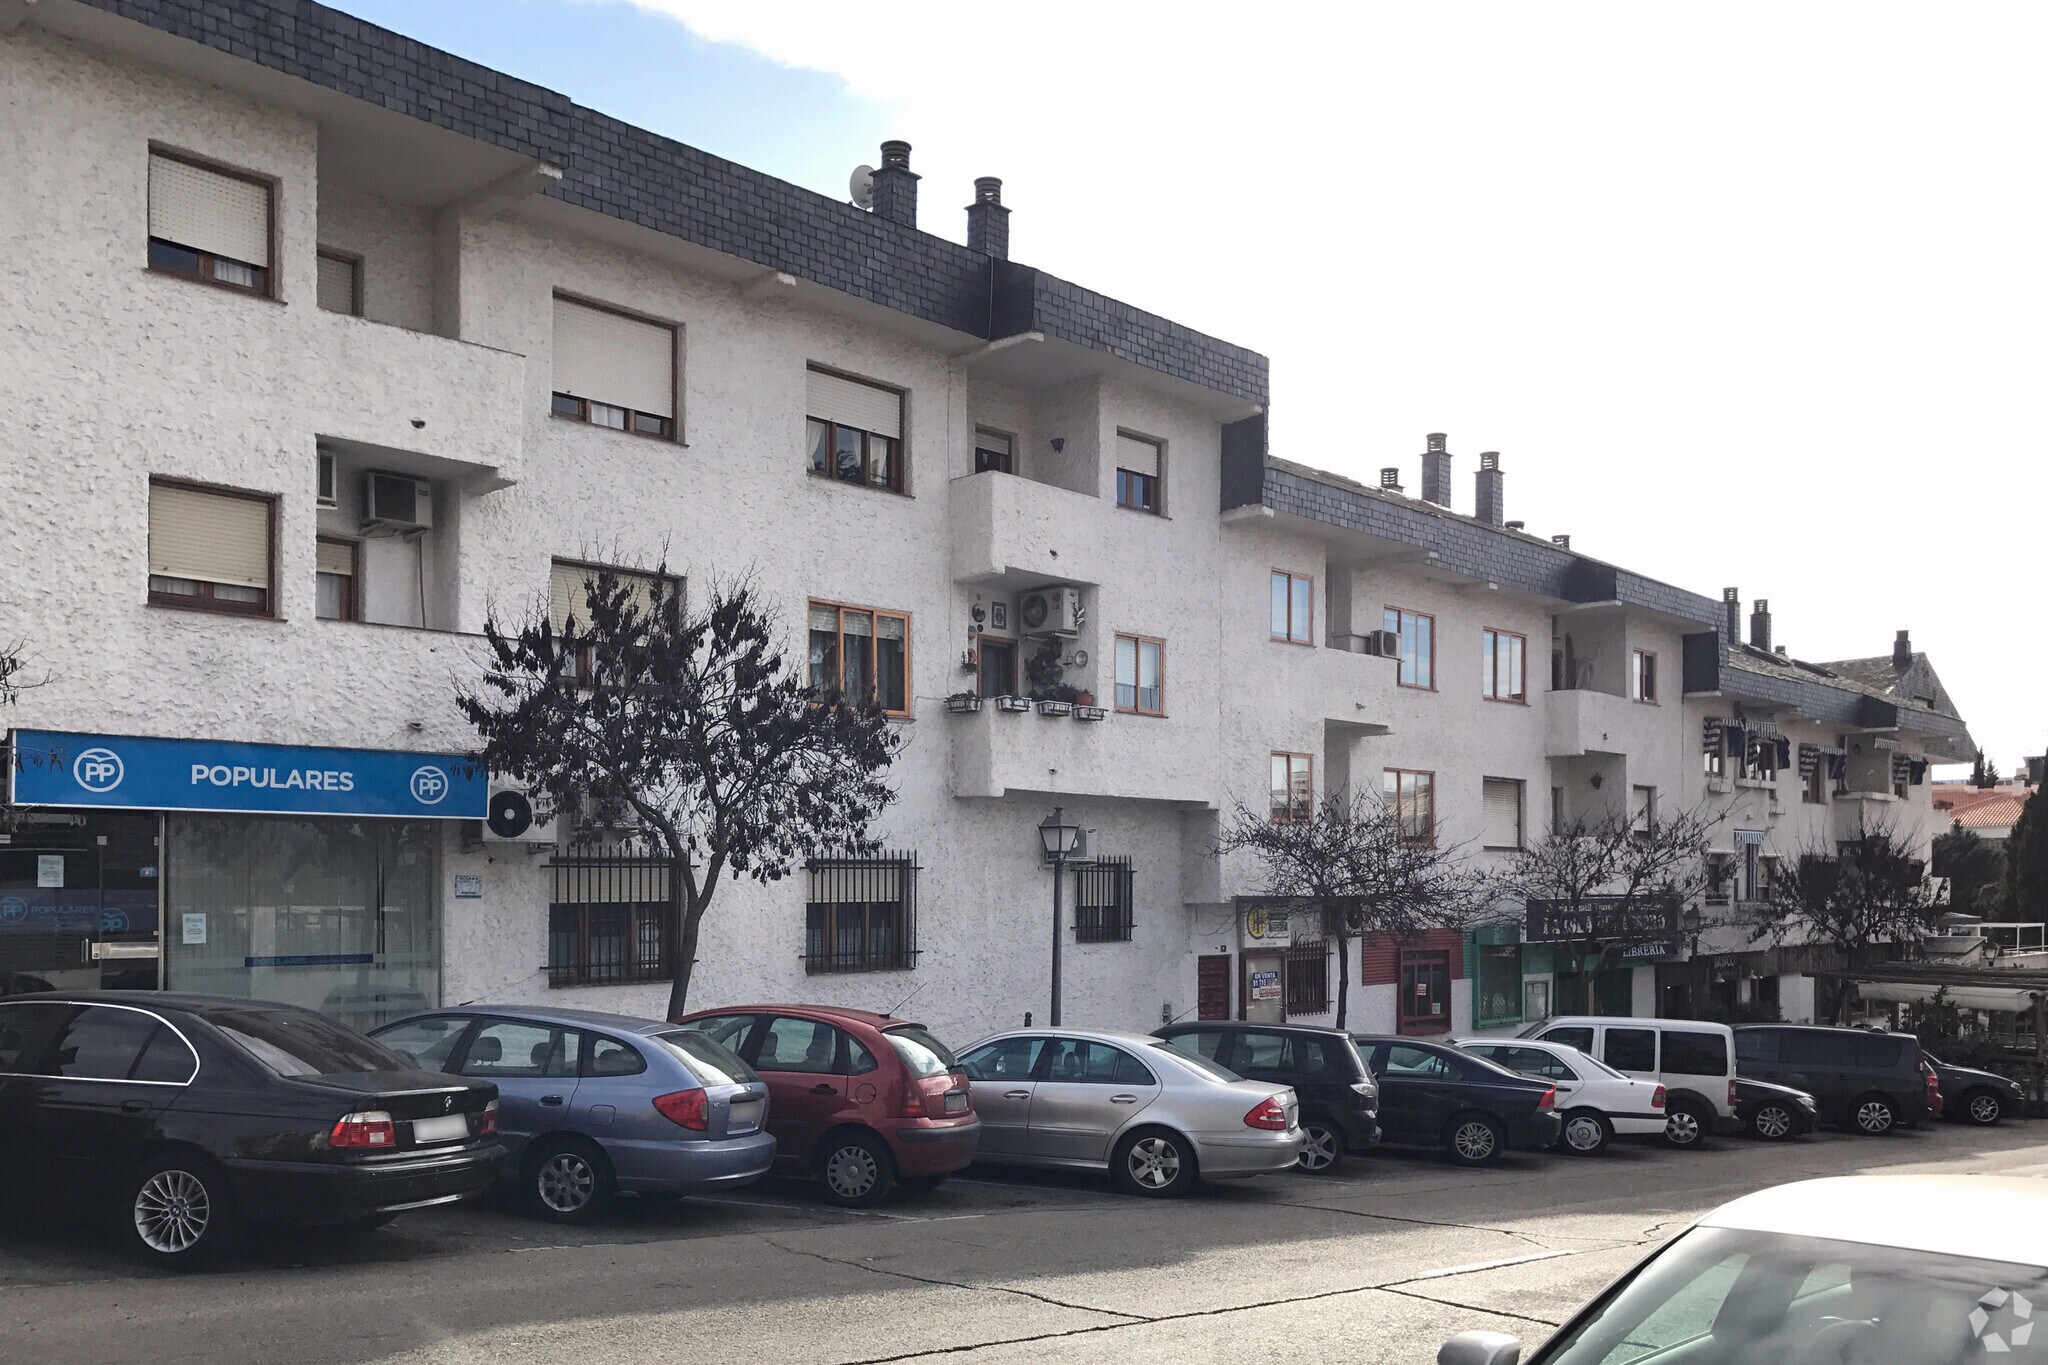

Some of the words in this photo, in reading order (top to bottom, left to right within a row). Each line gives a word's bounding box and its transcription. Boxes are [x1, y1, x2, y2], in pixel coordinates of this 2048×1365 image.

[85, 762, 116, 782] PP
[191, 764, 355, 791] POPULARES
[418, 778, 442, 796] PP
[30, 905, 97, 915] POPULARES
